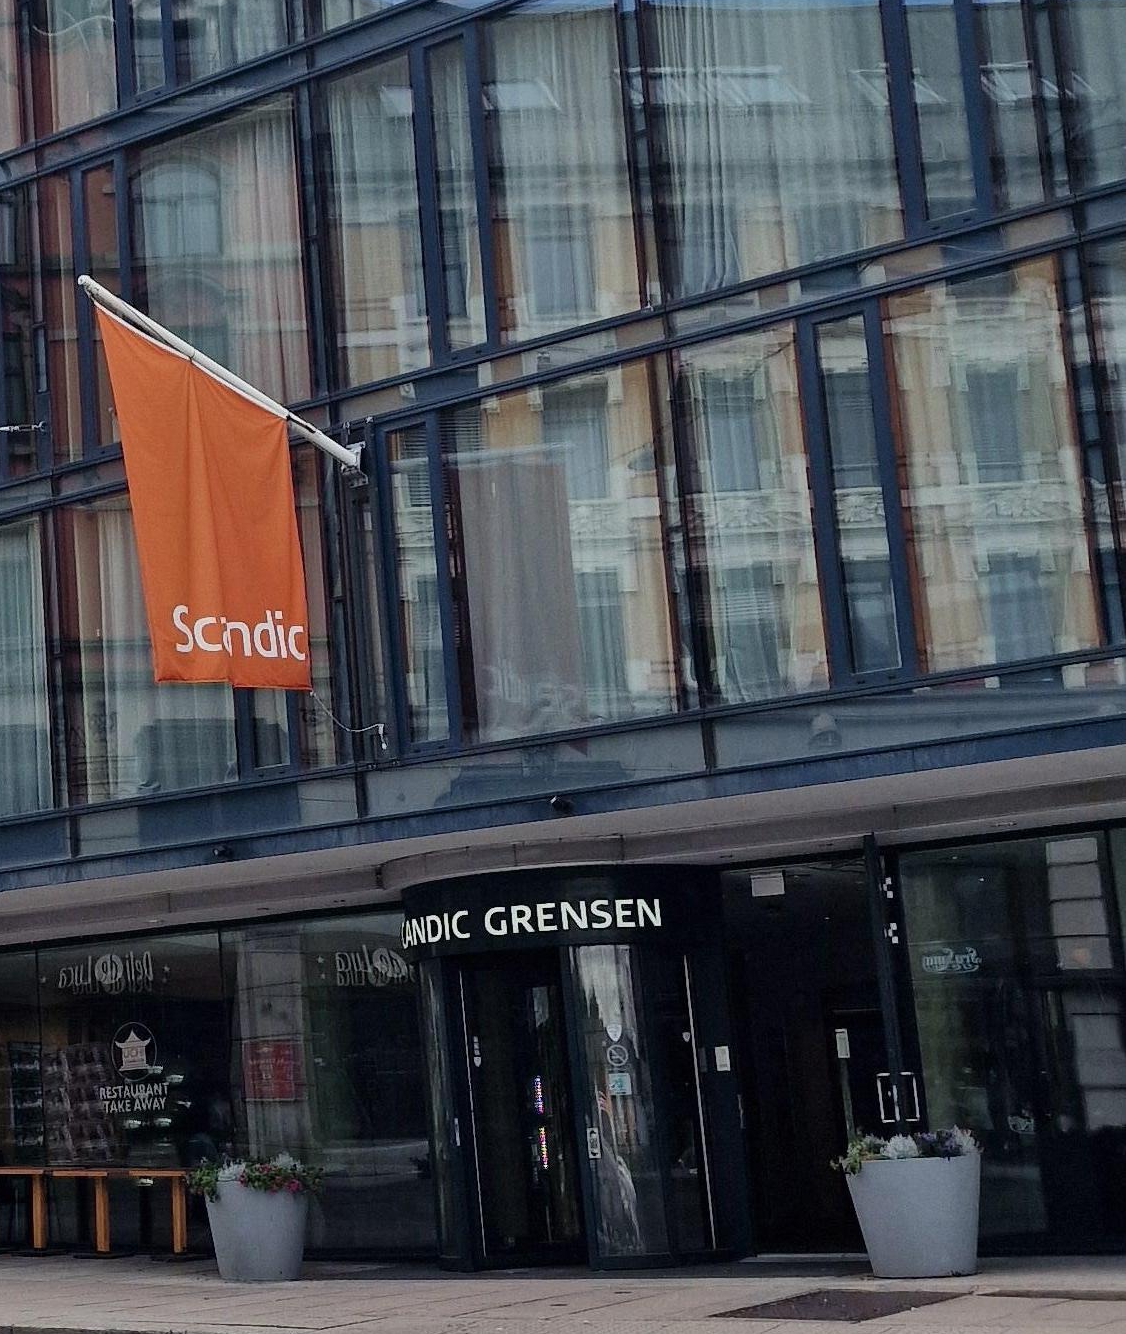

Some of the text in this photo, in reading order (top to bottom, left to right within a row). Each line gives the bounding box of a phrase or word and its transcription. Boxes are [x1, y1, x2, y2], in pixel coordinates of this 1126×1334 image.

[401, 898, 662, 949] CANDIC GRENSEN
[99, 1083, 170, 1100] RESTAURANT
[103, 1097, 167, 1114] TAKE AWAY
